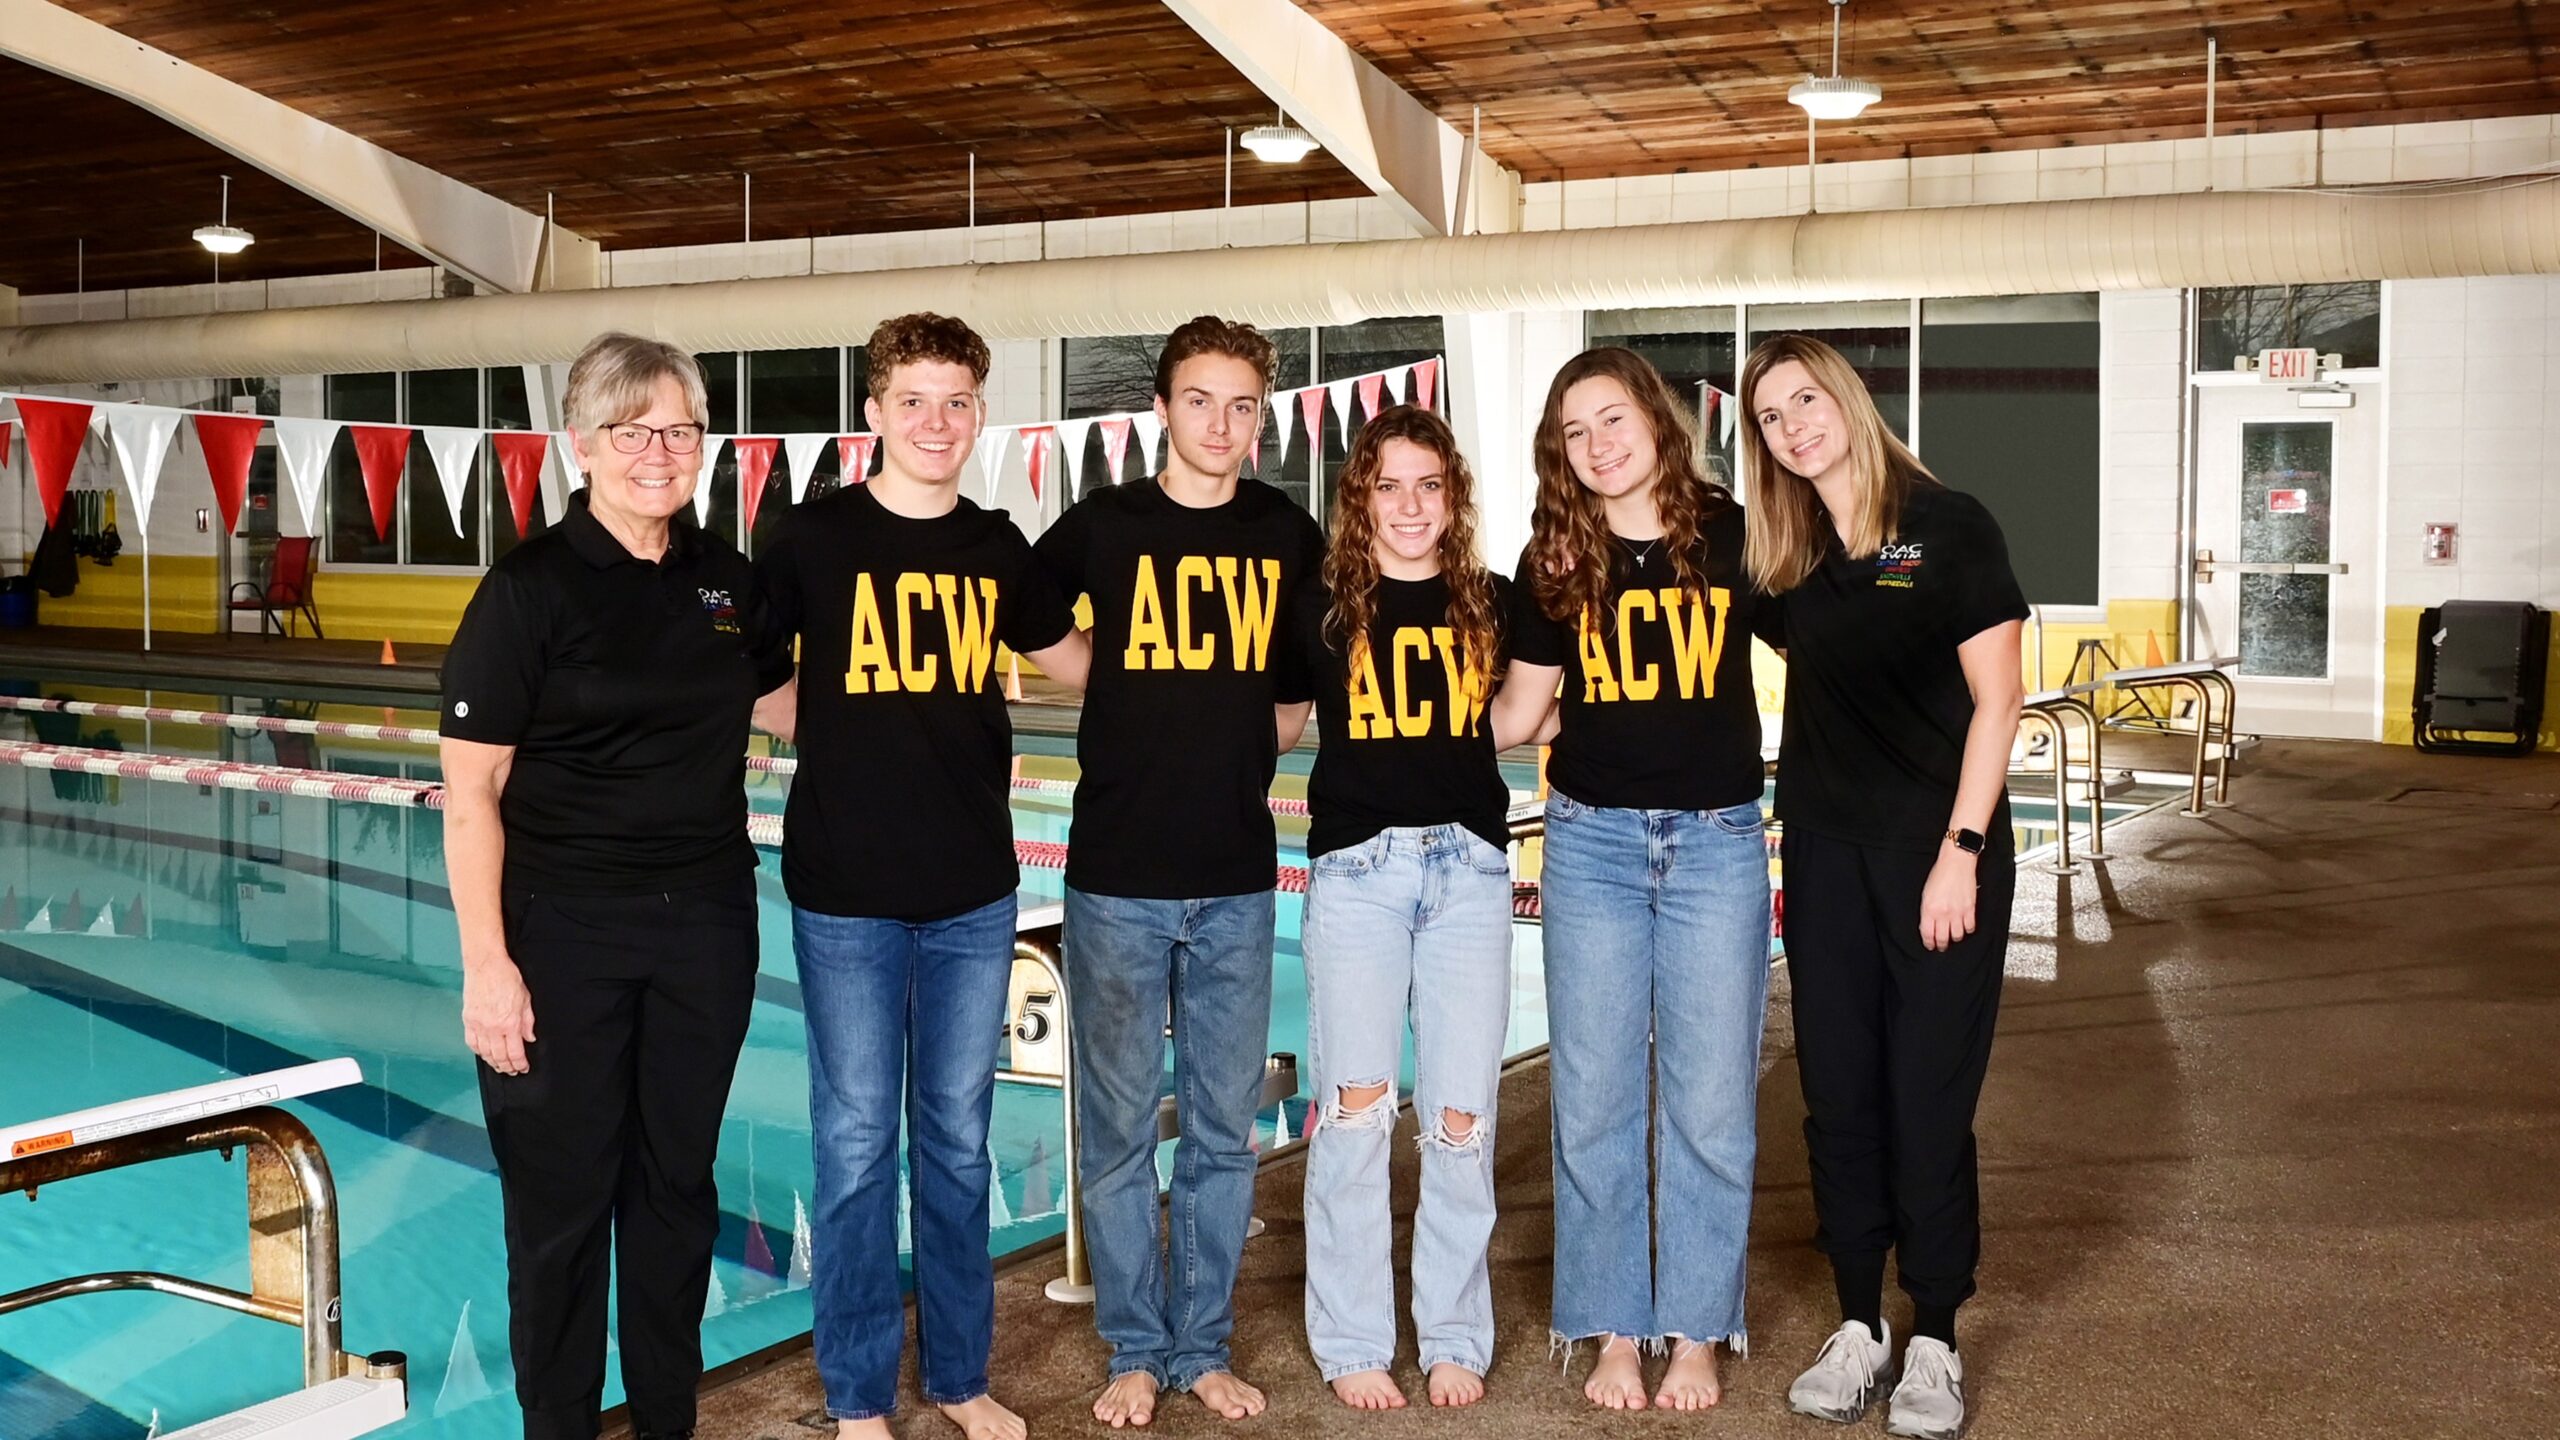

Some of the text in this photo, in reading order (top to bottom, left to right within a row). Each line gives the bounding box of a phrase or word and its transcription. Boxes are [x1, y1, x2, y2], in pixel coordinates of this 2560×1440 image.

[2269, 351, 2308, 378] EXIT
[1881, 544, 1923, 555] OAC
[1124, 555, 1281, 671] ACW
[845, 572, 998, 694] ACW
[1578, 587, 1731, 703] ACW
[2174, 698, 2197, 720] 1
[2026, 731, 2051, 758] 2
[1015, 990, 1056, 1044] 5
[28, 1135, 66, 1150] WARNING
[325, 1296, 341, 1322] 6
